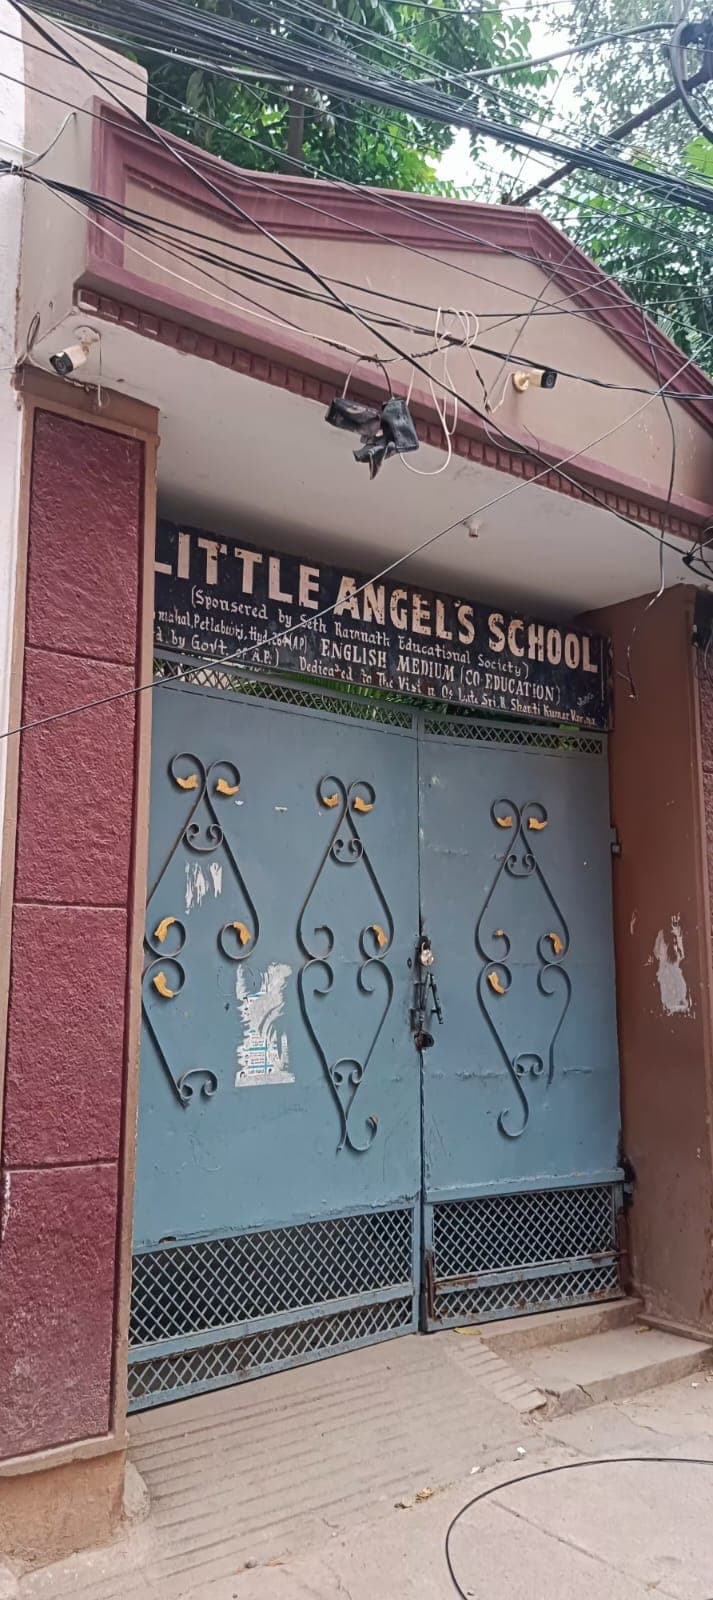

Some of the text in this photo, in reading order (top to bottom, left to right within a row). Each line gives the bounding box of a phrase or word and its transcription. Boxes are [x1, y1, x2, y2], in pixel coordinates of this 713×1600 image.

[170, 629, 186, 649] by
[278, 609, 292, 629] by
[300, 615, 327, 634] Seth
[398, 635, 471, 665] Educational
[477, 653, 529, 680] Society)
[321, 638, 387, 669] ENGLISH
[396, 654, 455, 682] MEDIUM
[488, 613, 598, 673] SCHOOL
[376, 671, 393, 689] The
[398, 676, 436, 697] Visin
